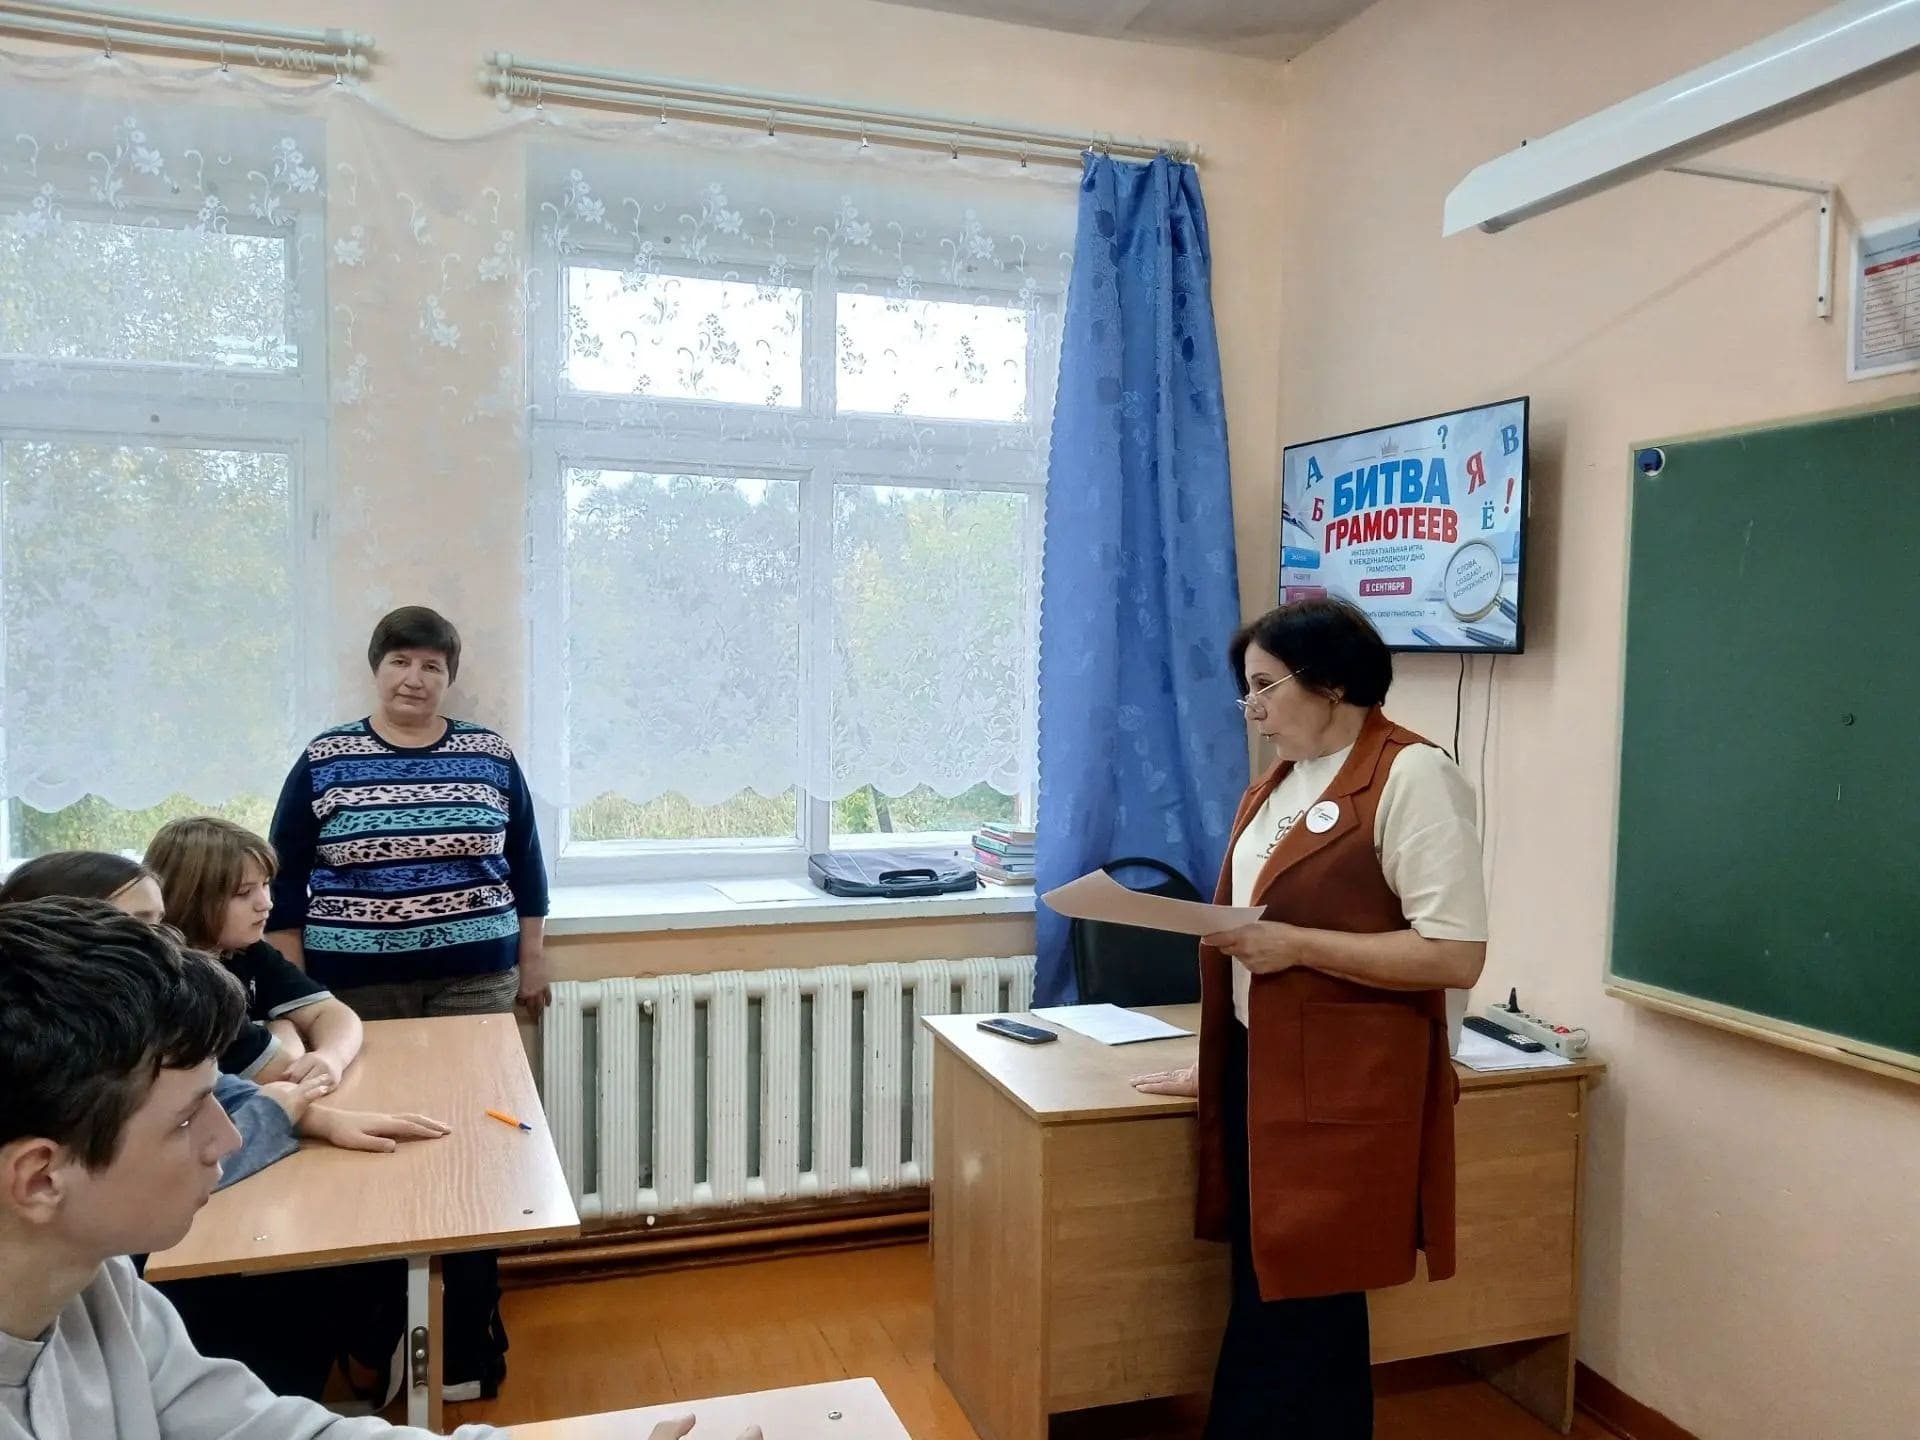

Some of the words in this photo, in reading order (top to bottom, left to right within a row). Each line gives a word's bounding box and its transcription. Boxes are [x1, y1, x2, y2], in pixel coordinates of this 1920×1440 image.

[1437, 424, 1449, 450] ?
[1501, 424, 1520, 456] В
[1305, 455, 1324, 490] А
[1466, 452, 1487, 495] Я
[1333, 457, 1451, 518] БИТВА
[1503, 478, 1515, 514] !
[1311, 497, 1325, 522] Б
[1481, 501, 1495, 530] Ё
[1324, 507, 1459, 554] ГРАМОТЕЕВ
[1351, 545, 1408, 556] ИНТЕЛЛЕКТУАЛЬНАЯ
[1409, 544, 1424, 552] ИГРА
[1354, 554, 1410, 565] МЕЖДУНАРОДНОМУ
[1410, 553, 1426, 562] ДНЮ
[1366, 564, 1407, 573] ГРАМОТНОСТИ
[1371, 581, 1405, 592] СЕНТЯБРЯ
